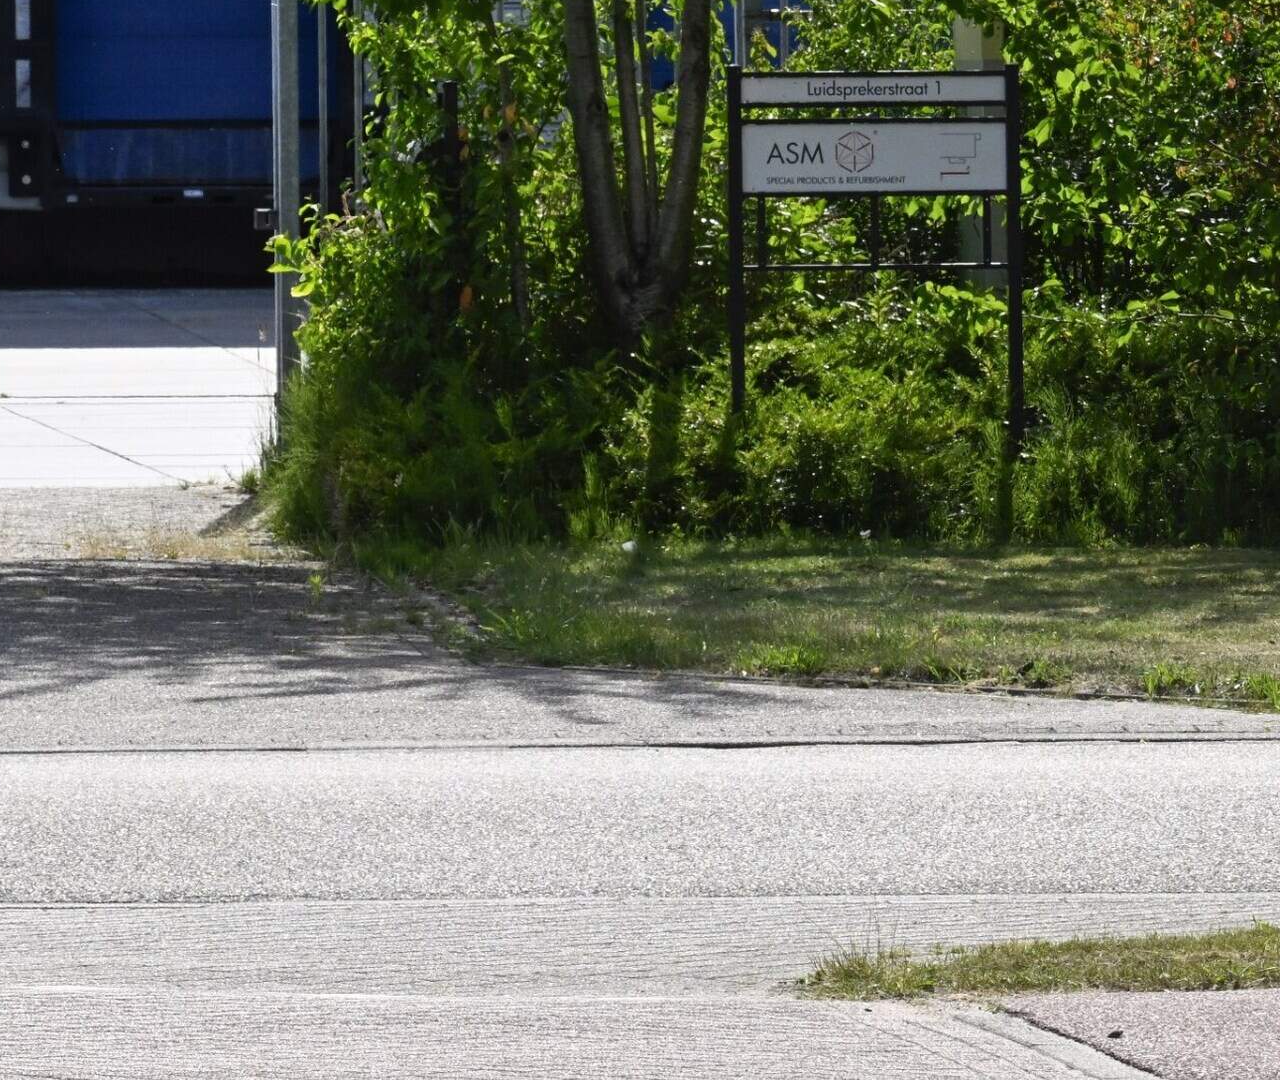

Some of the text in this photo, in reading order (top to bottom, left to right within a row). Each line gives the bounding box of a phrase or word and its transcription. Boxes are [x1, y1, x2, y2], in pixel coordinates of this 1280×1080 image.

[807, 80, 941, 100] Luidsprekerstraat 1
[766, 142, 824, 164] ASM
[766, 176, 794, 184] SPECIAL
[796, 176, 836, 184] PRODUCTS
